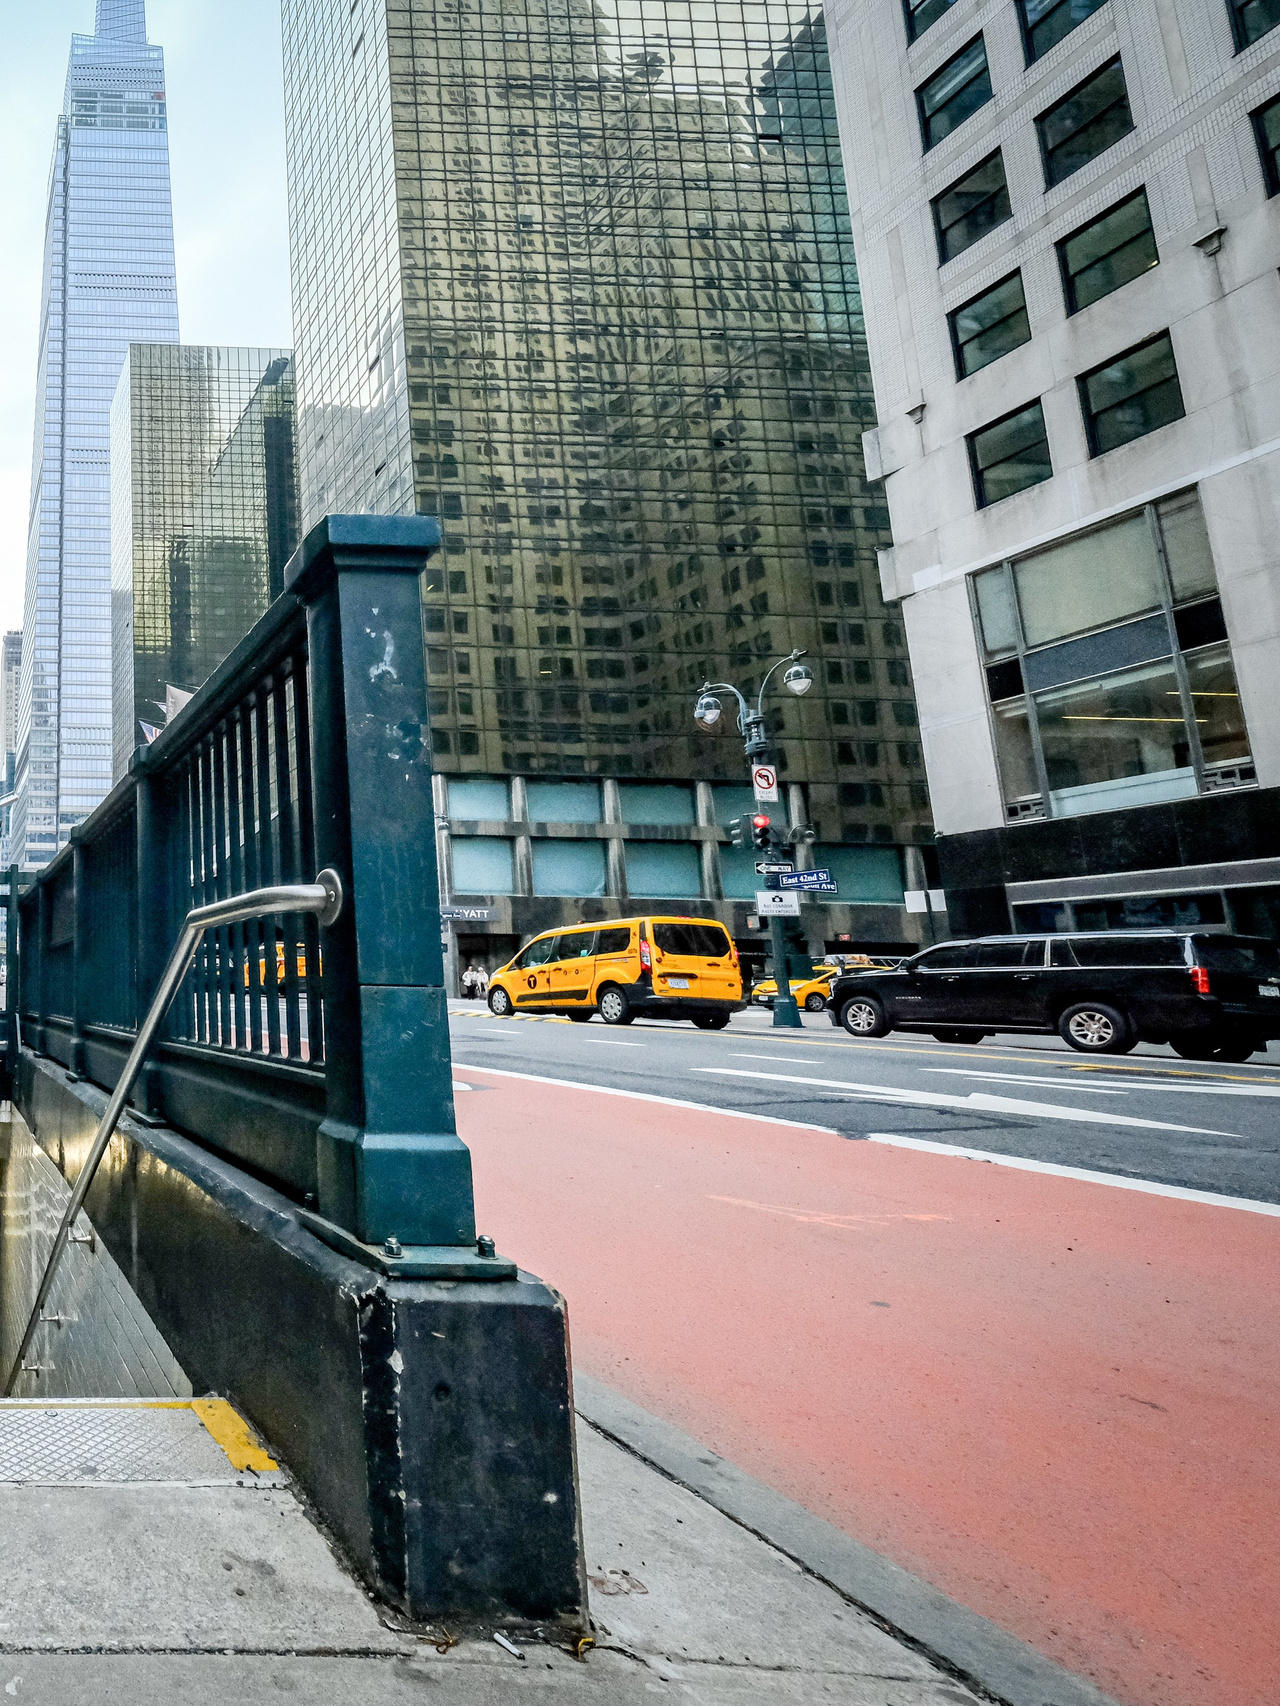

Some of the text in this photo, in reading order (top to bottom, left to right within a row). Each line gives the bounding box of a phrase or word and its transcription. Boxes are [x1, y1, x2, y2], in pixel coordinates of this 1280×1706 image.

[782, 872, 827, 885] East 42nd St
[454, 909, 489, 918] YATT
